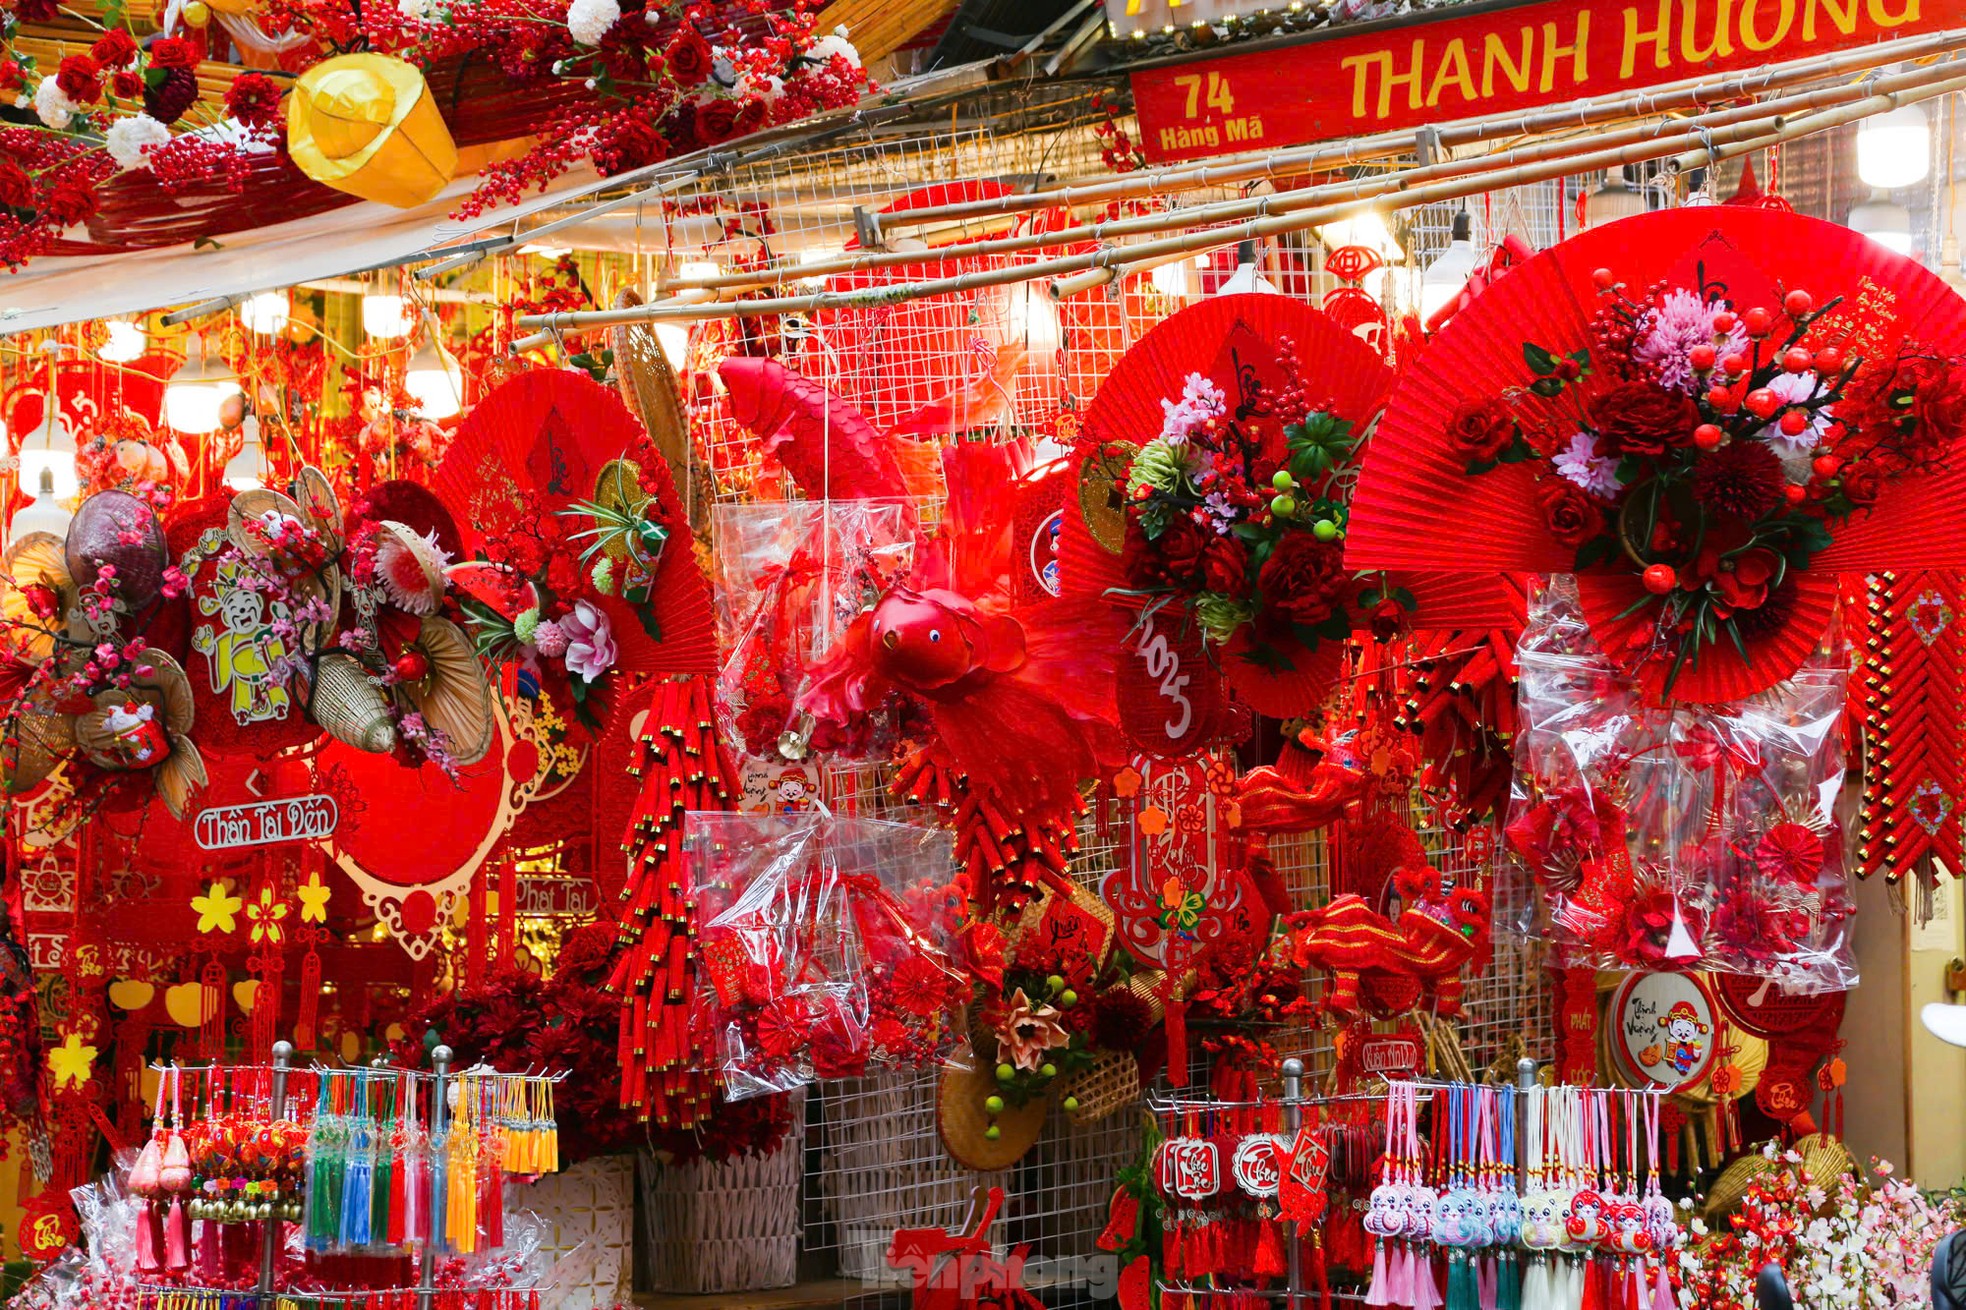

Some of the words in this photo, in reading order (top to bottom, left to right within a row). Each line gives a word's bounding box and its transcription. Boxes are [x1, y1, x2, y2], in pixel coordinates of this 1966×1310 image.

[1341, 9, 1590, 118] THANH
[1174, 70, 1235, 119] 74
[1159, 124, 1219, 150] Hàng
[1226, 114, 1264, 142] Mã
[1133, 610, 1192, 739] 2025
[202, 808, 251, 848] Thần
[254, 803, 284, 841] Tài
[287, 799, 330, 838] Đến
[560, 879, 587, 912] Tài
[1570, 1006, 1592, 1031] PHÁT
